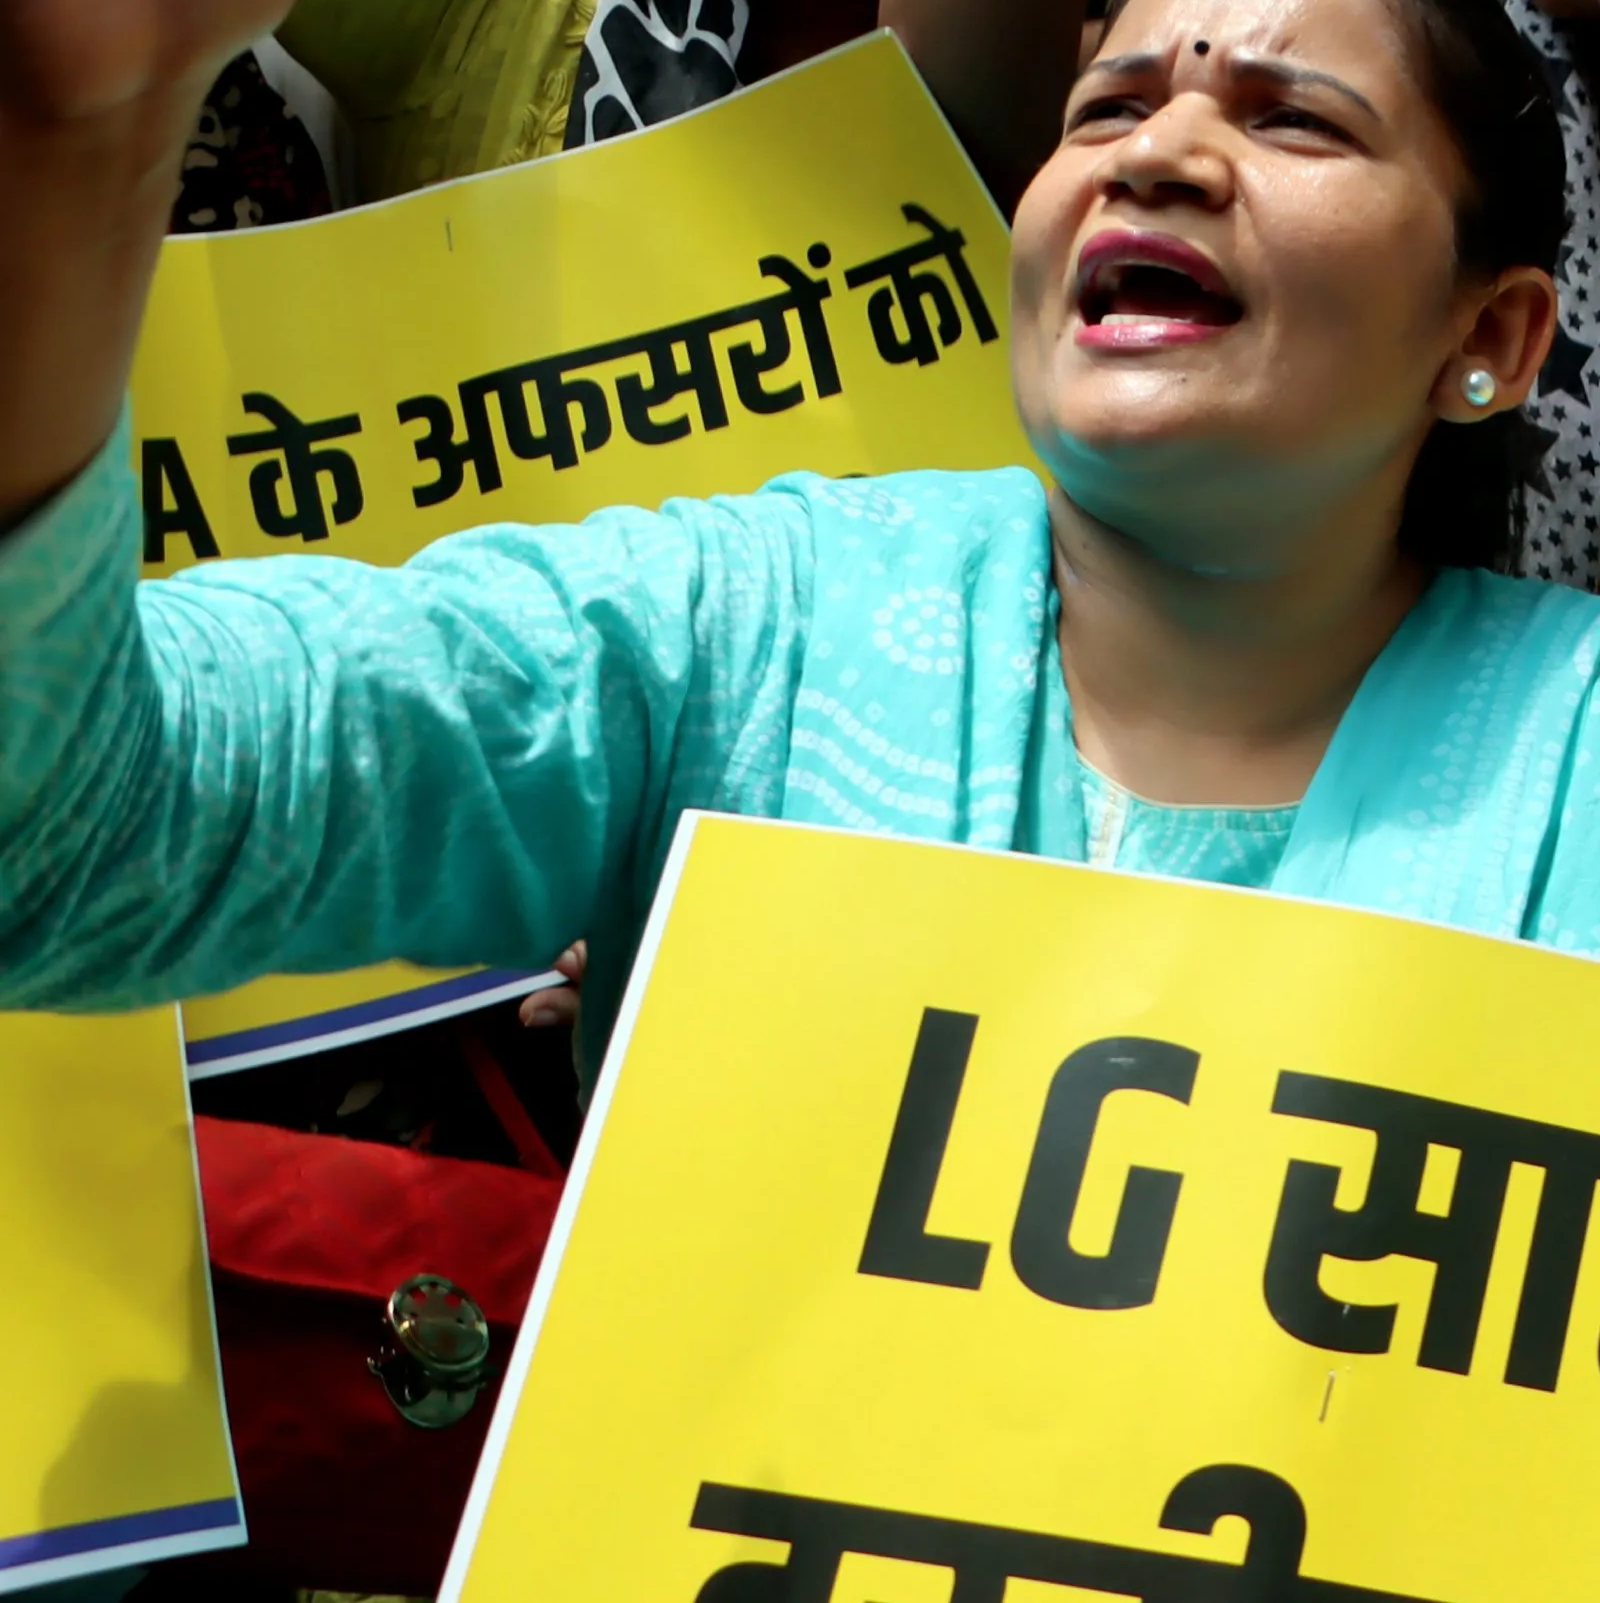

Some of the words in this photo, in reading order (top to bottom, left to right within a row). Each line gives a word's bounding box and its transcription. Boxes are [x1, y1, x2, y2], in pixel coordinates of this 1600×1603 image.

[227, 392, 364, 542] के
[397, 242, 842, 510] अफसरों
[844, 202, 999, 367] को
[857, 1007, 1202, 1312] LG
